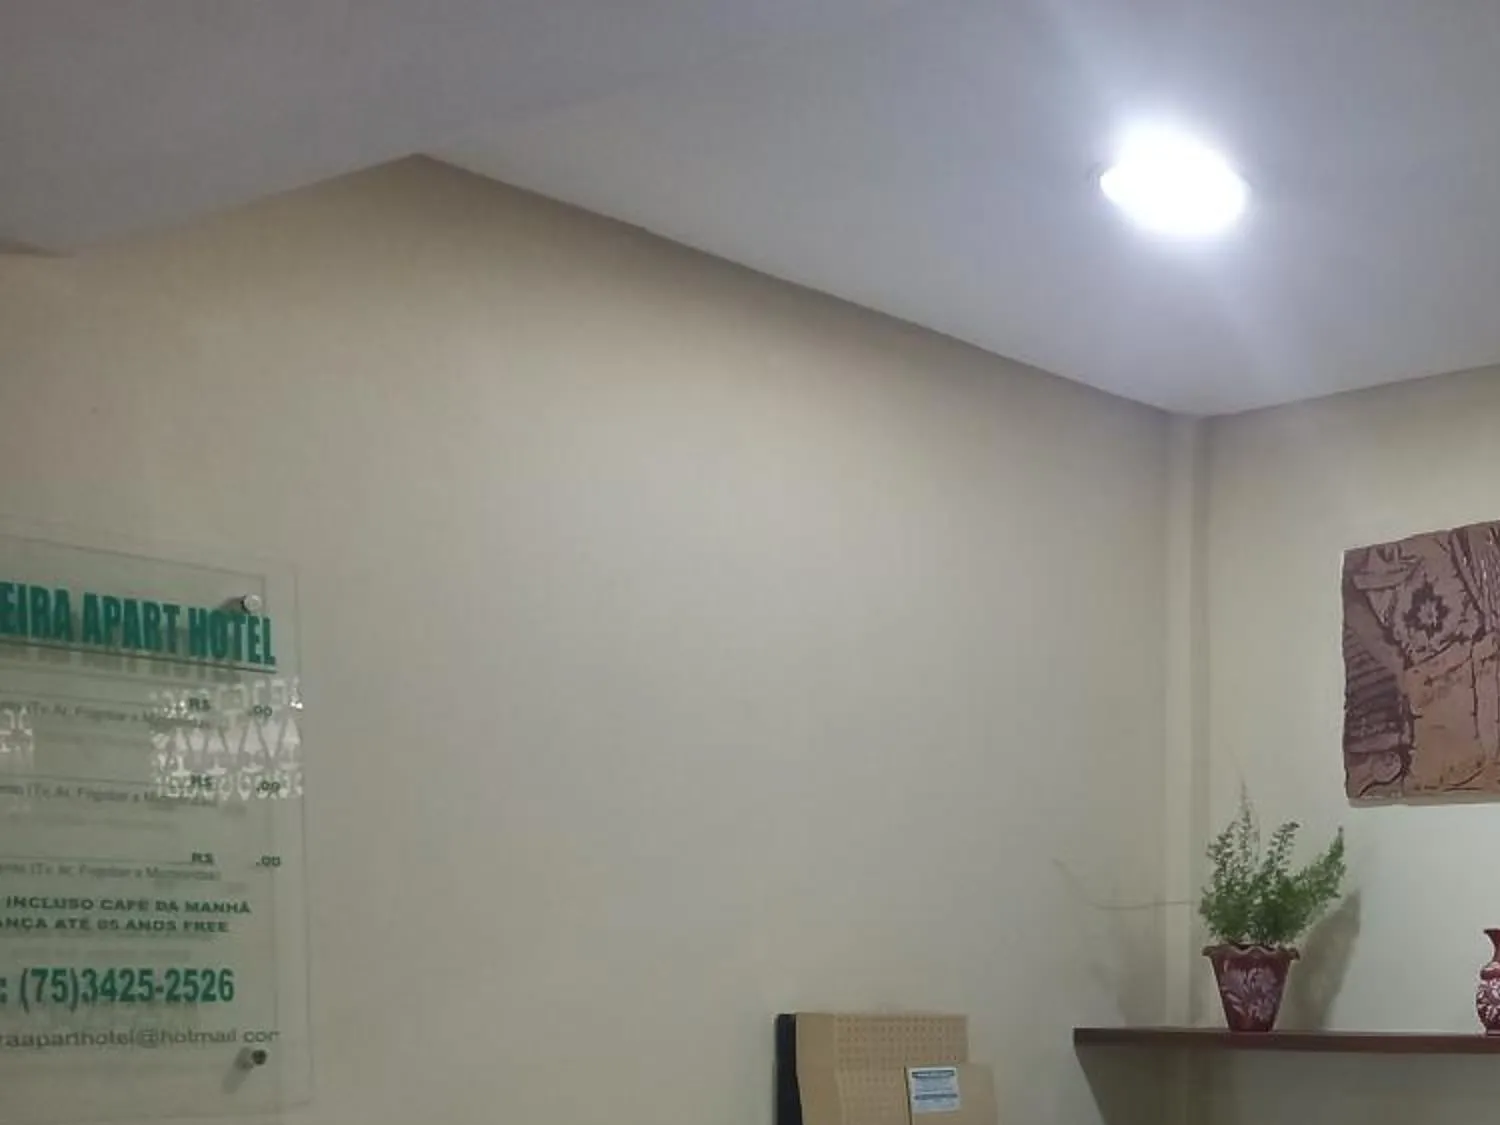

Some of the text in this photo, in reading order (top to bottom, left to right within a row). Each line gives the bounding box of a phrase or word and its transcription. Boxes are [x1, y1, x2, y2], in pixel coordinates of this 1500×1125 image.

[82, 591, 181, 655] APART
[187, 606, 277, 667] HOTEL
[6, 895, 95, 911] INCLUSO
[155, 900, 179, 913] DA
[126, 918, 177, 931] ANOS
[183, 920, 230, 933] FREE
[19, 966, 236, 1014] (75)3425-2526
